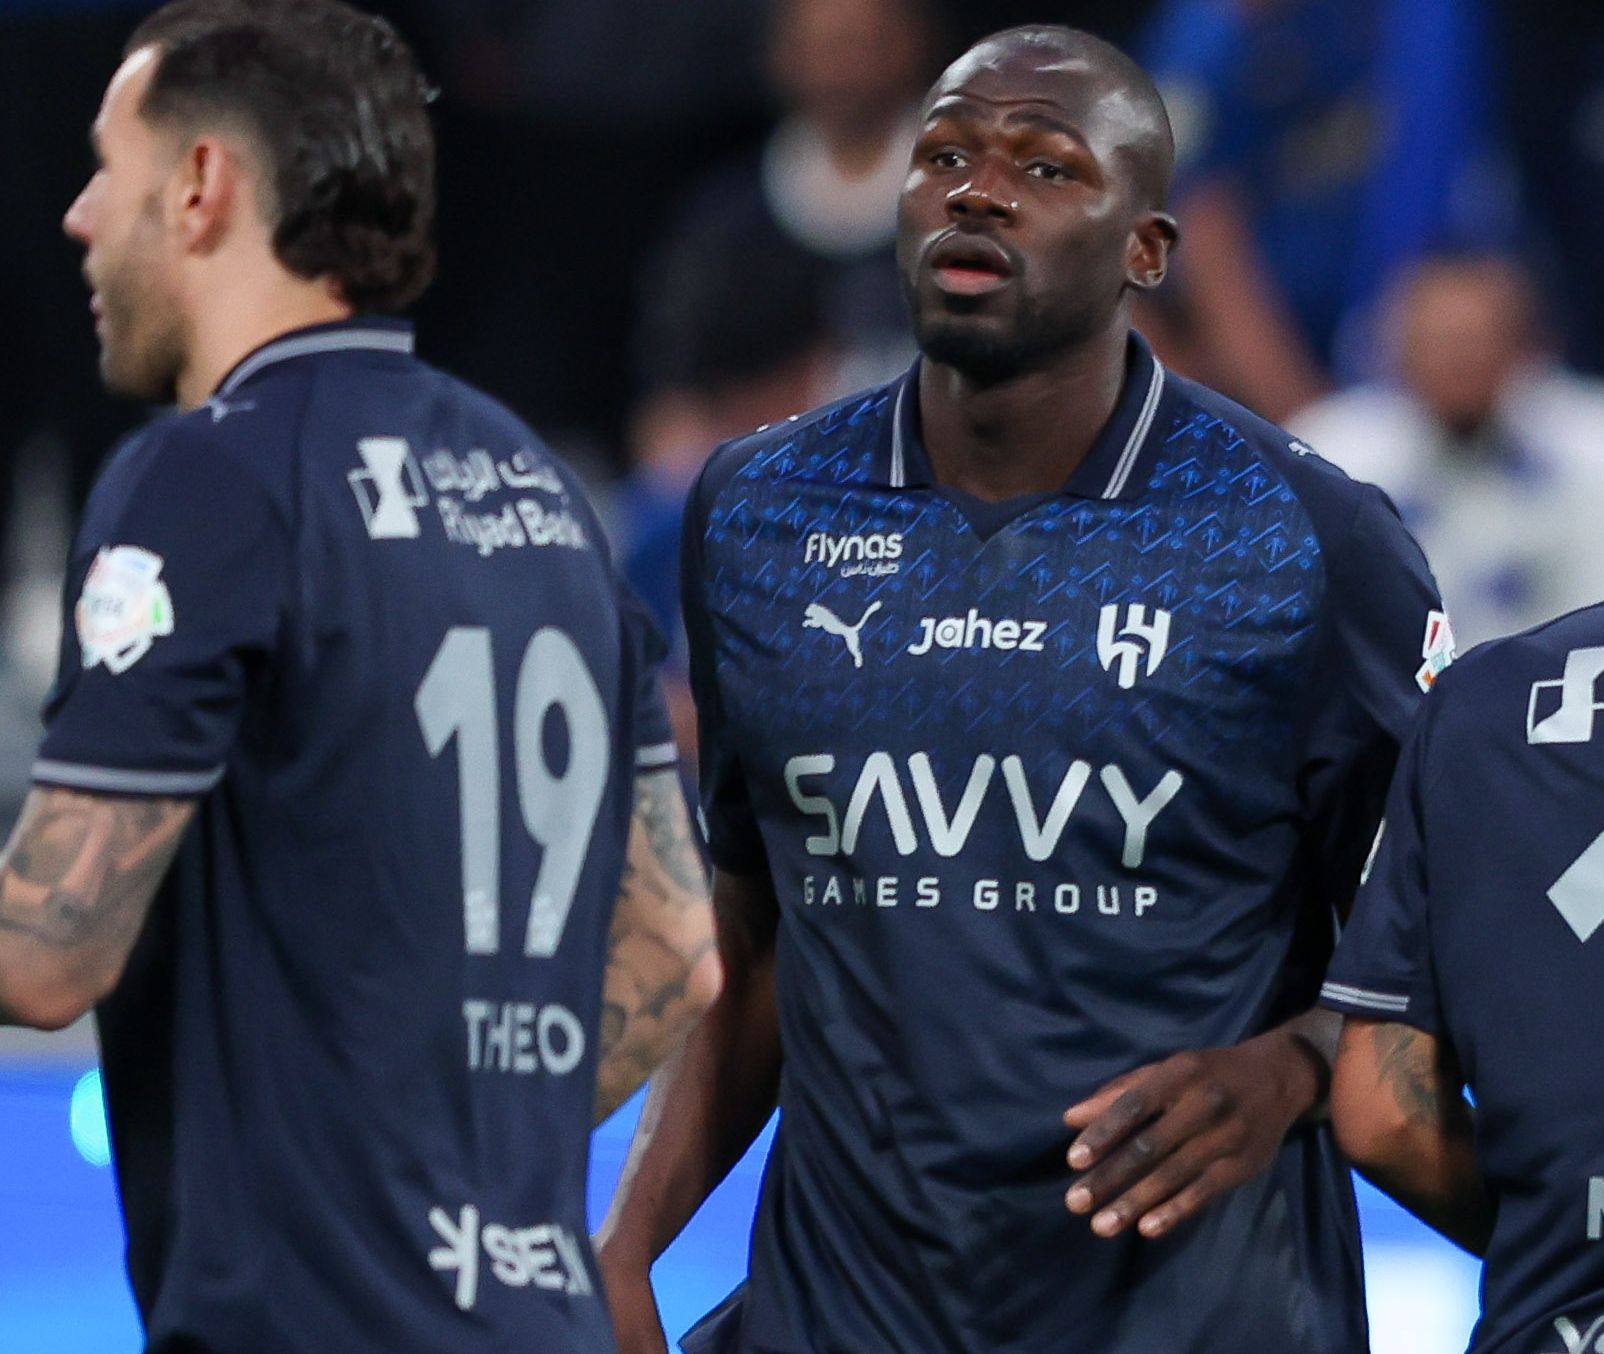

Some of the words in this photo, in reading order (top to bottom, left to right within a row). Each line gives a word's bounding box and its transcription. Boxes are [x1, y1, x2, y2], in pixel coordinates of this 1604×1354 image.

[804, 533, 903, 567] flynas
[414, 626, 610, 957] 19
[784, 751, 1184, 868] SAVVY
[803, 875, 941, 908] GAMES
[972, 878, 1159, 917] GROUP
[462, 1000, 586, 1075] THEO
